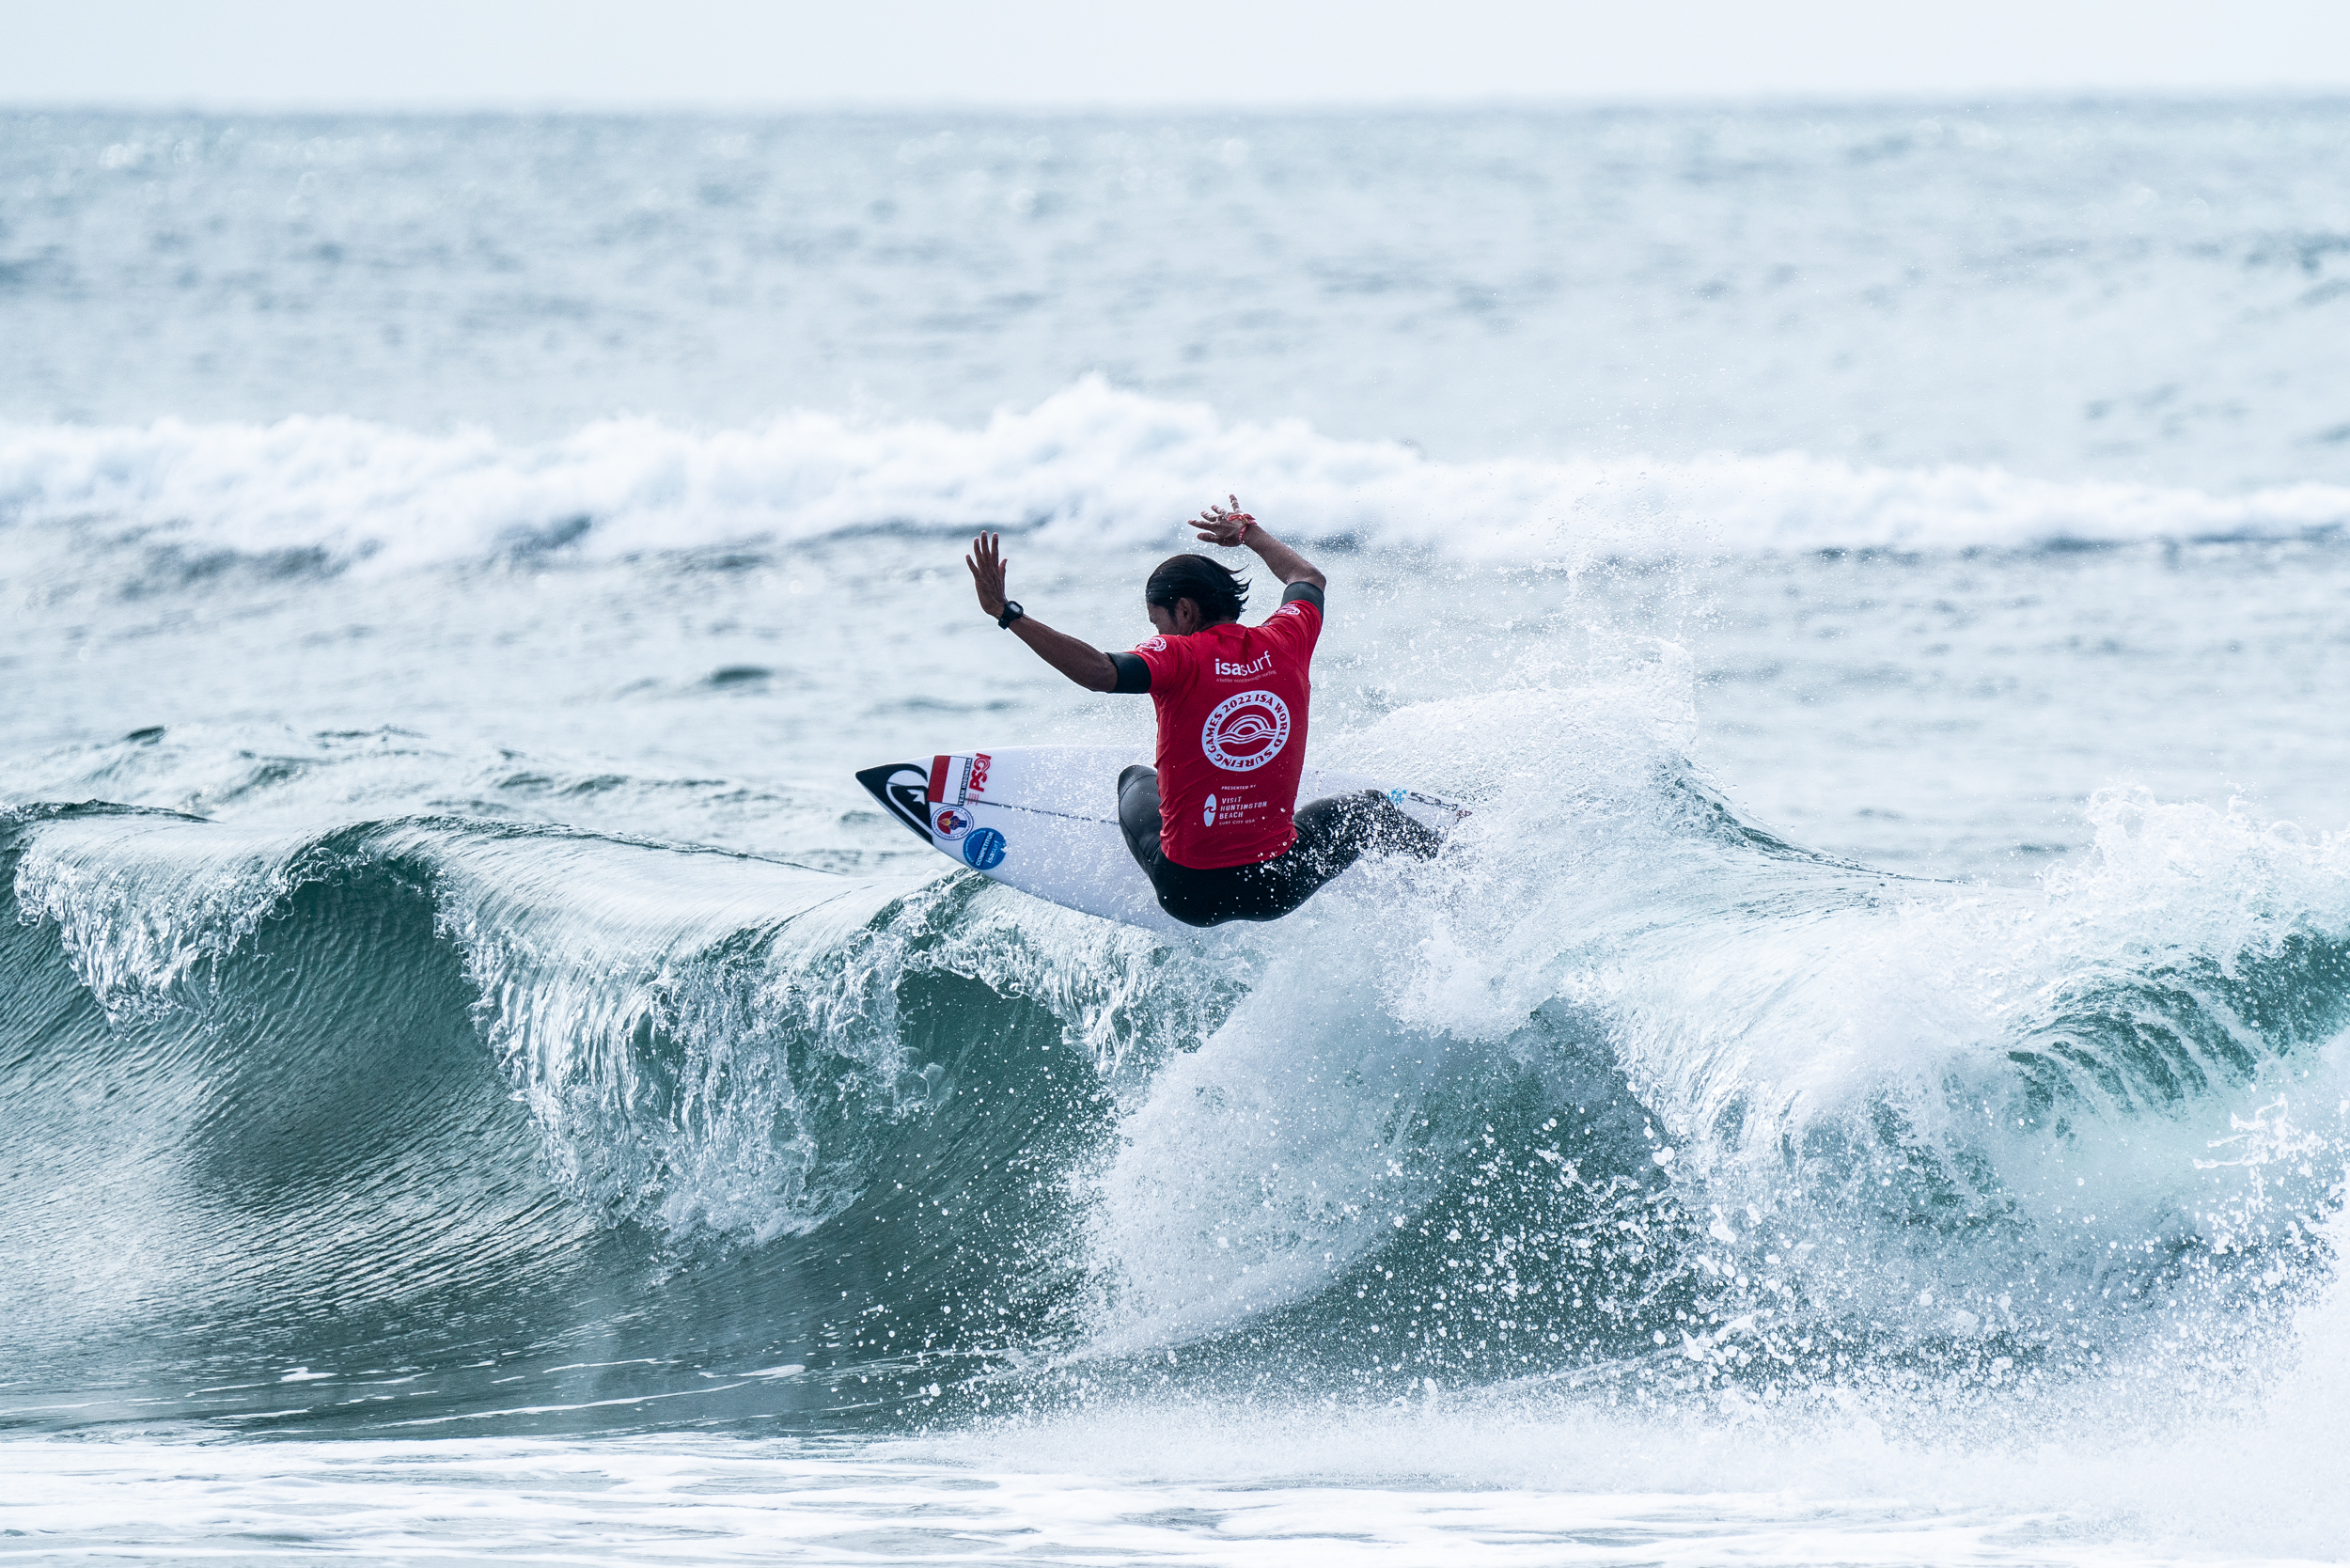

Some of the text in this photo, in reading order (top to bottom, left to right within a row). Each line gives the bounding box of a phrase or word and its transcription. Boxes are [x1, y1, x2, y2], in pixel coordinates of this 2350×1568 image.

[1214, 650, 1272, 677] isasurf
[1206, 694, 1288, 768] 2022 ISA WORLD SURFING GAMES
[962, 758, 972, 789] INDONESIA
[1219, 811, 1244, 820] BEACH
[1220, 801, 1267, 811] HUNTINGTON
[976, 831, 995, 866] COMPETITOR
[986, 839, 1000, 864] isasurf
